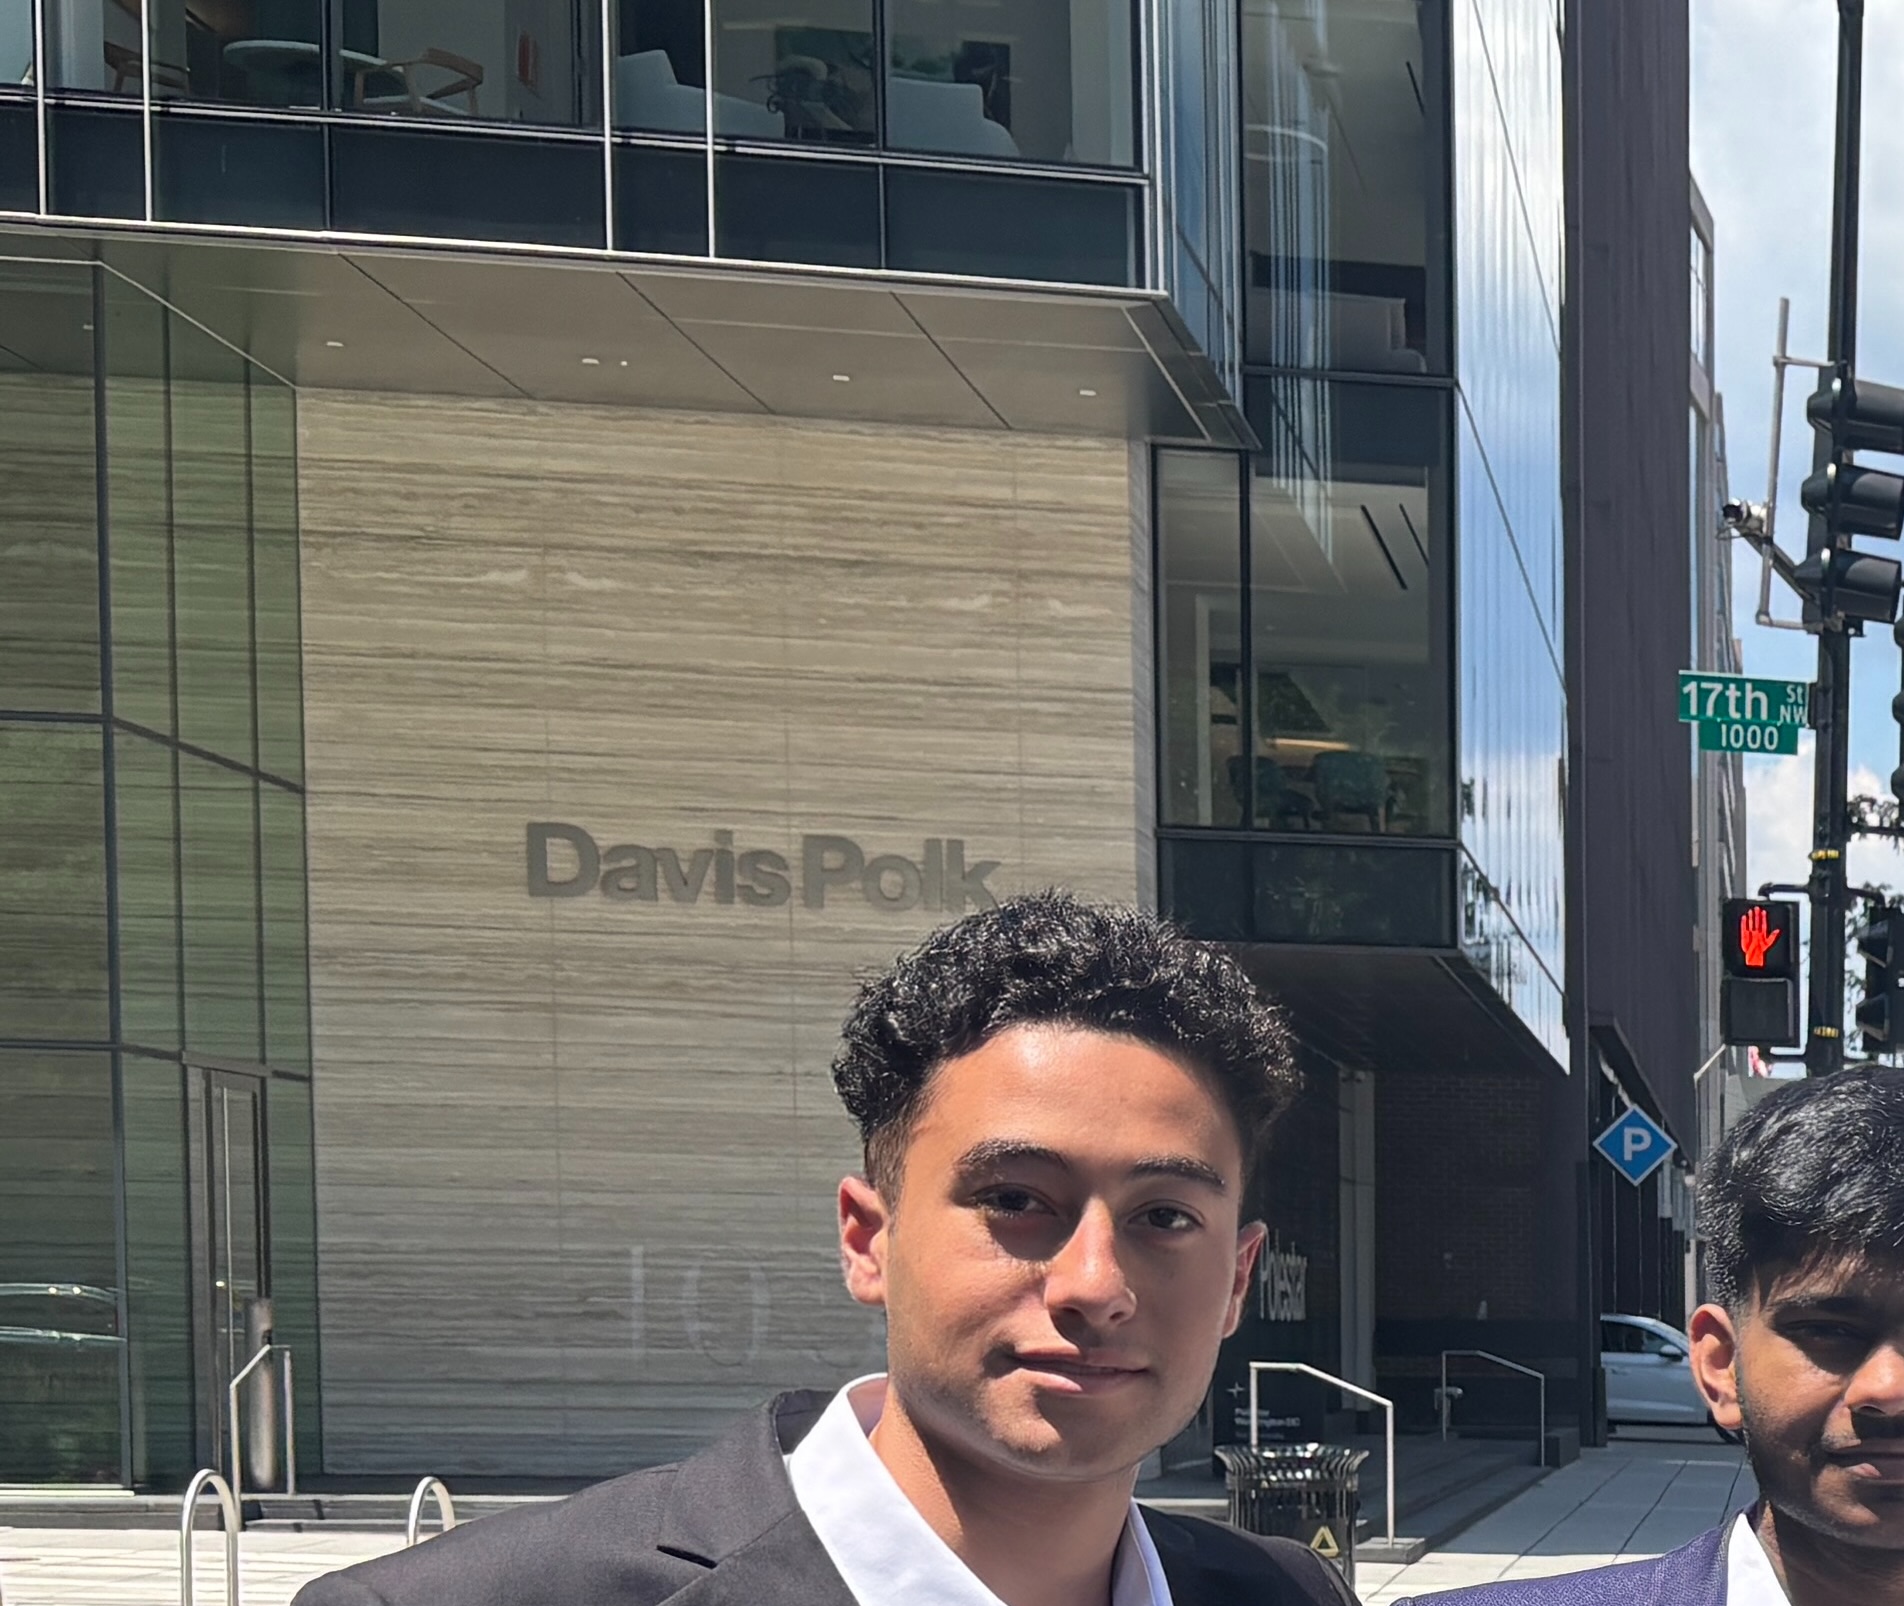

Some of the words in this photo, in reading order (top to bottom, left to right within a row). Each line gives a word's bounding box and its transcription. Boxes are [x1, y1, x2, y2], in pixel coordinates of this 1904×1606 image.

[1682, 681, 1768, 721] 17th
[1786, 684, 1805, 705] St
[1779, 704, 1808, 725] NW
[1721, 723, 1779, 751] 1000
[526, 821, 792, 908] Davis
[803, 834, 1001, 914] Polk
[1623, 1127, 1652, 1161] P
